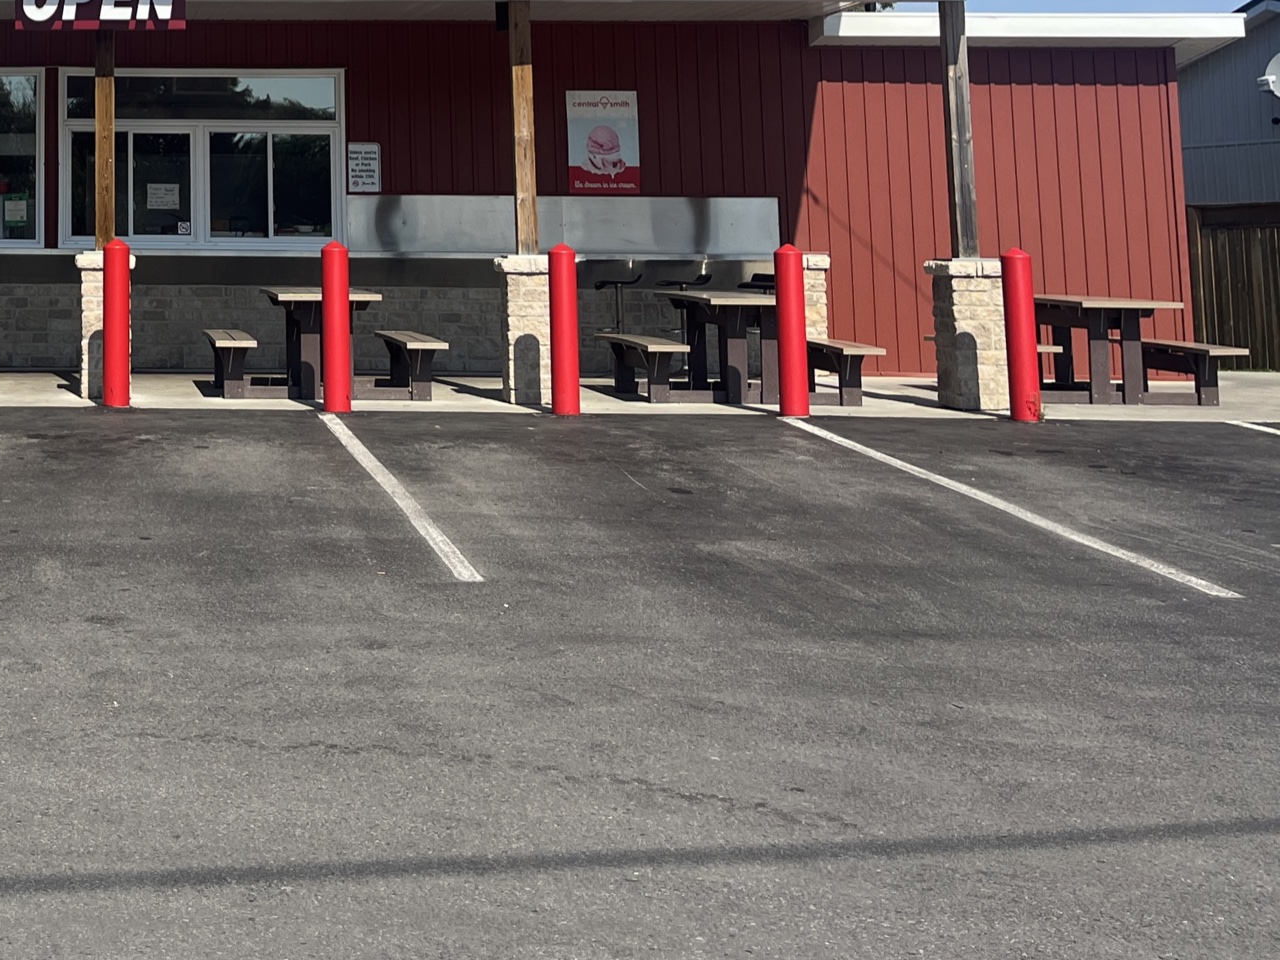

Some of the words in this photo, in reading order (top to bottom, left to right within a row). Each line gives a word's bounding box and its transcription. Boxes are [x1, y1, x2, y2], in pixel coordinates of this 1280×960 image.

[572, 100, 599, 108] central
[610, 100, 630, 108] smith
[584, 180, 602, 188] dream
